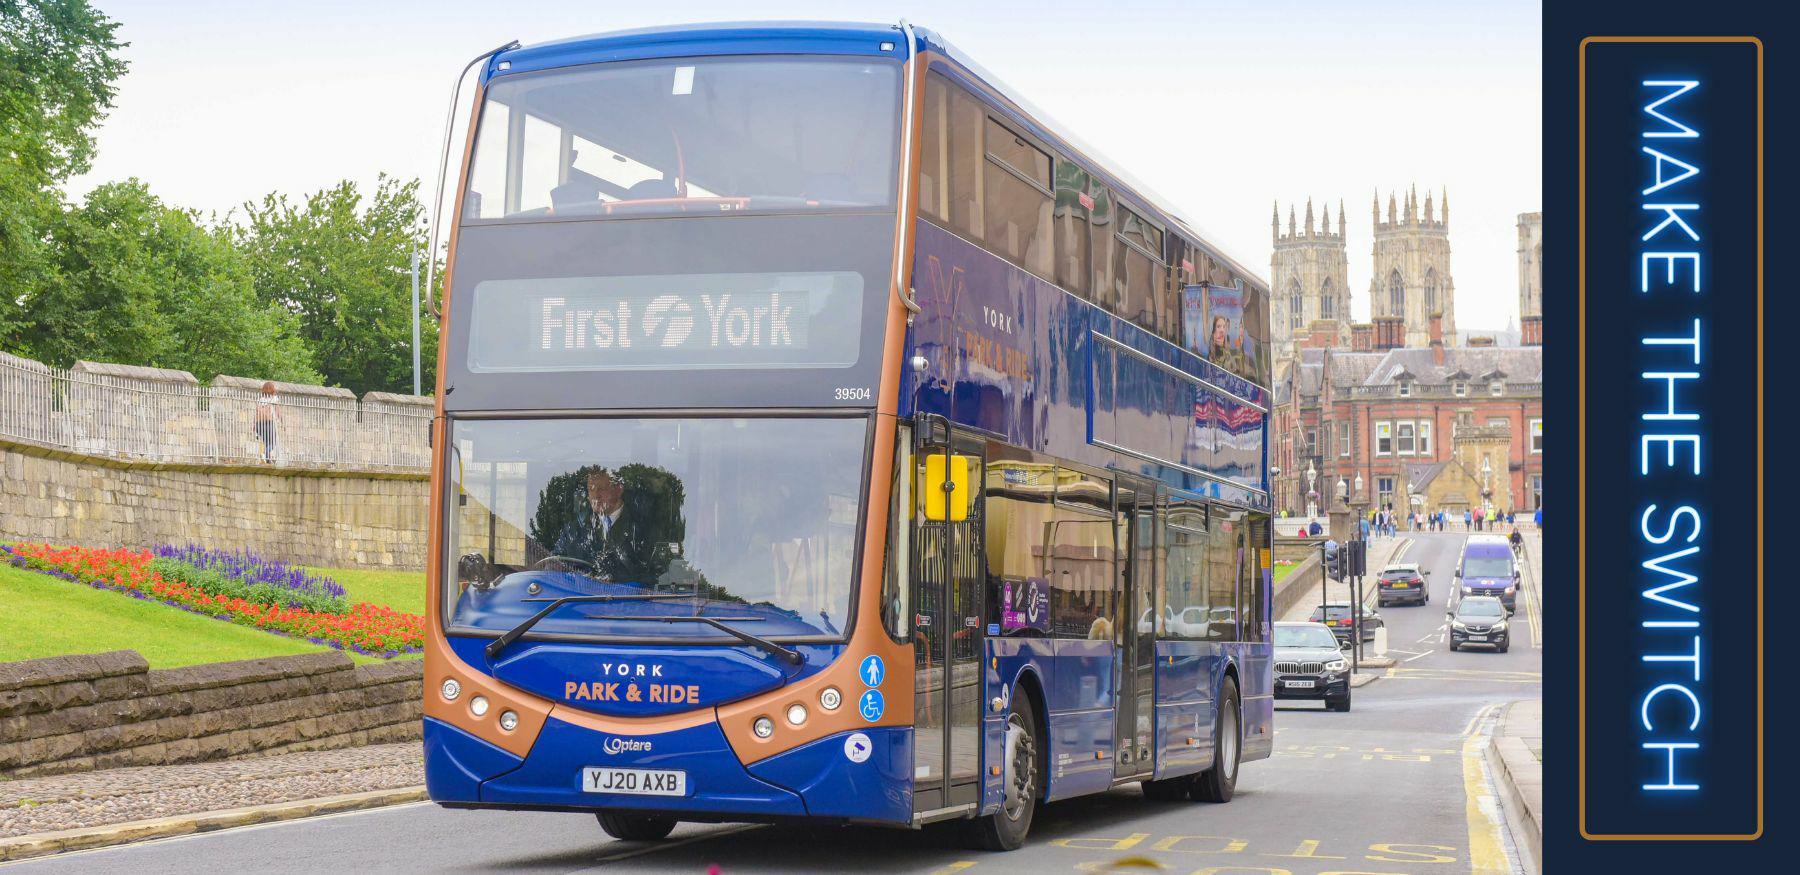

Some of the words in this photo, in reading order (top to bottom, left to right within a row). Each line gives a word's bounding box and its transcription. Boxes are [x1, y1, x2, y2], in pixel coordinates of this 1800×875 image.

[542, 297, 631, 349] First
[701, 293, 792, 347] York
[984, 306, 1012, 334] YORK
[835, 387, 870, 400] 39504
[602, 663, 663, 677] YORK
[565, 681, 620, 701] PARK
[626, 683, 642, 702] &
[649, 684, 700, 704] RIDE
[612, 738, 652, 754] Optare
[591, 771, 637, 790] YJ20
[642, 773, 677, 791] AXB
[1049, 832, 1457, 863] STOP
